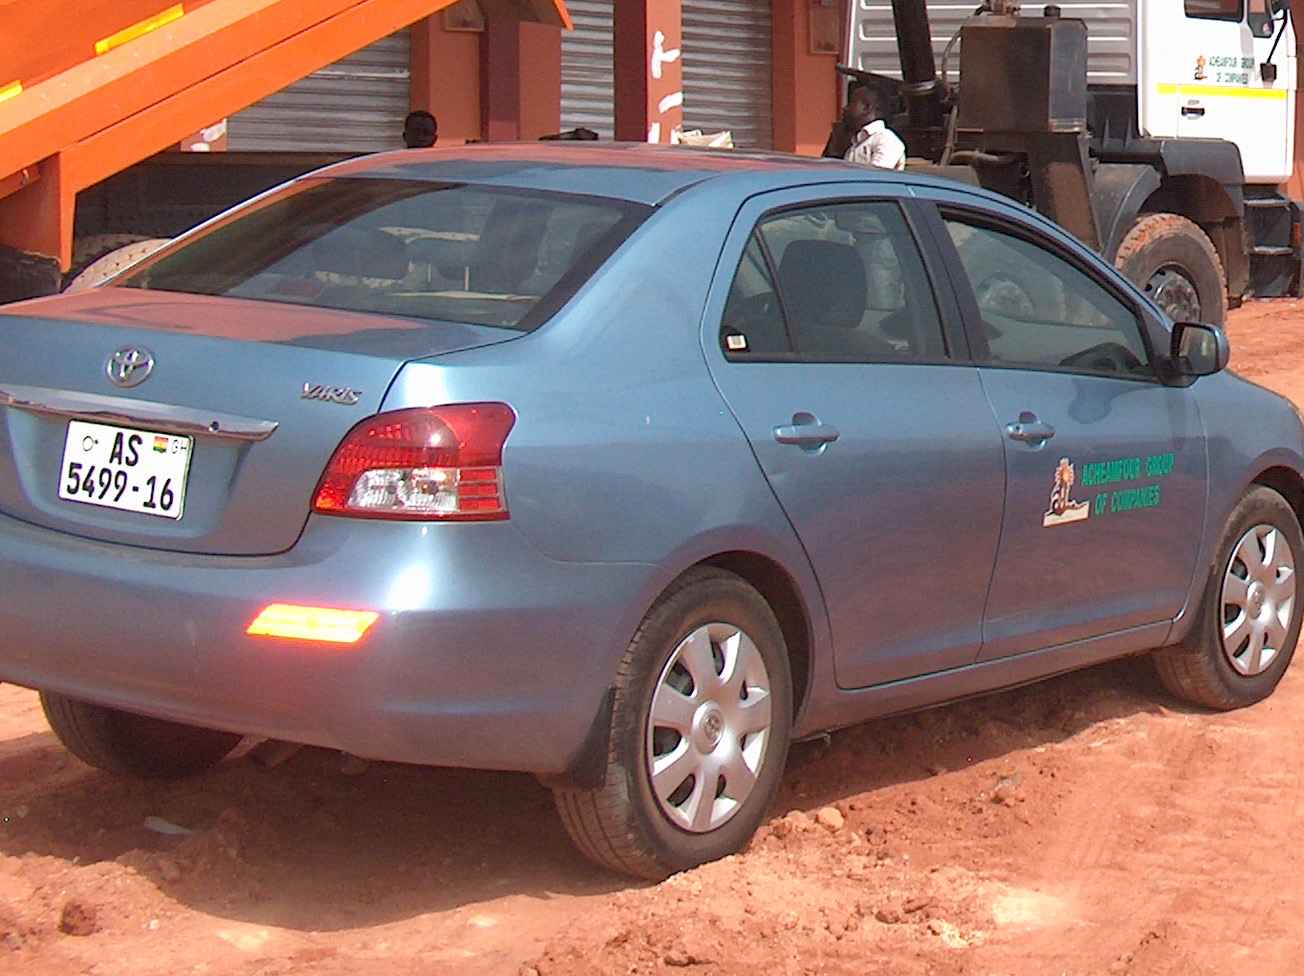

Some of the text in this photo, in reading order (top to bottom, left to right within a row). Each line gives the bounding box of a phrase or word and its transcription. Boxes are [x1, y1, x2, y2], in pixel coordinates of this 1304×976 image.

[302, 382, 362, 405] YARIS
[109, 431, 143, 467] AS
[66, 462, 174, 511] 5499-16
[1094, 493, 1108, 515] OF
